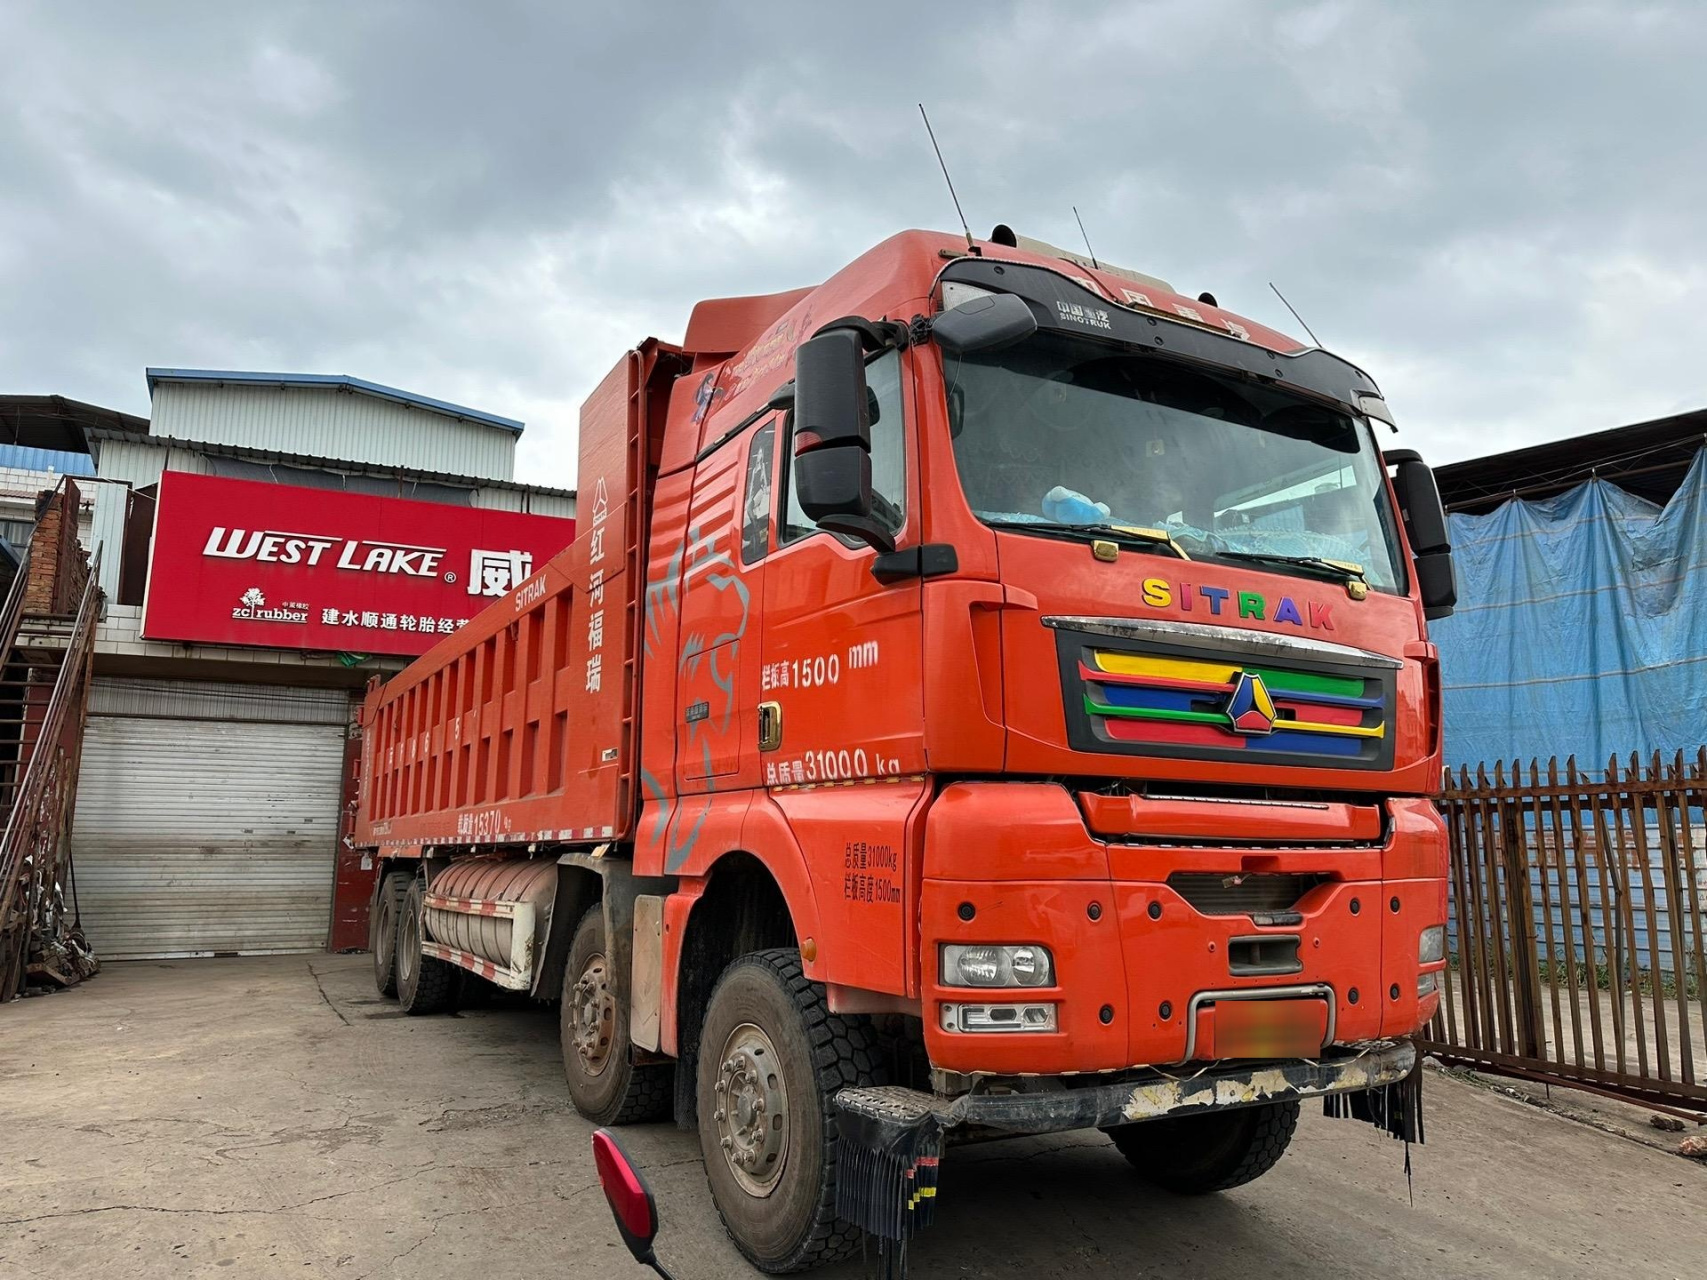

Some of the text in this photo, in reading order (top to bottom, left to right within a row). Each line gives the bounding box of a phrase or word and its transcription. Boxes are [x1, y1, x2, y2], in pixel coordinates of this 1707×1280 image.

[1059, 311, 1112, 330] SINOTRUK
[203, 527, 342, 565] WEST
[337, 540, 447, 577] LAKE
[467, 548, 533, 598] 威
[256, 607, 308, 622] rubber
[515, 574, 546, 612] SITRAK
[585, 527, 605, 694] 红河福瑞
[1142, 578, 1335, 631] SITRAK
[849, 640, 879, 669] mm
